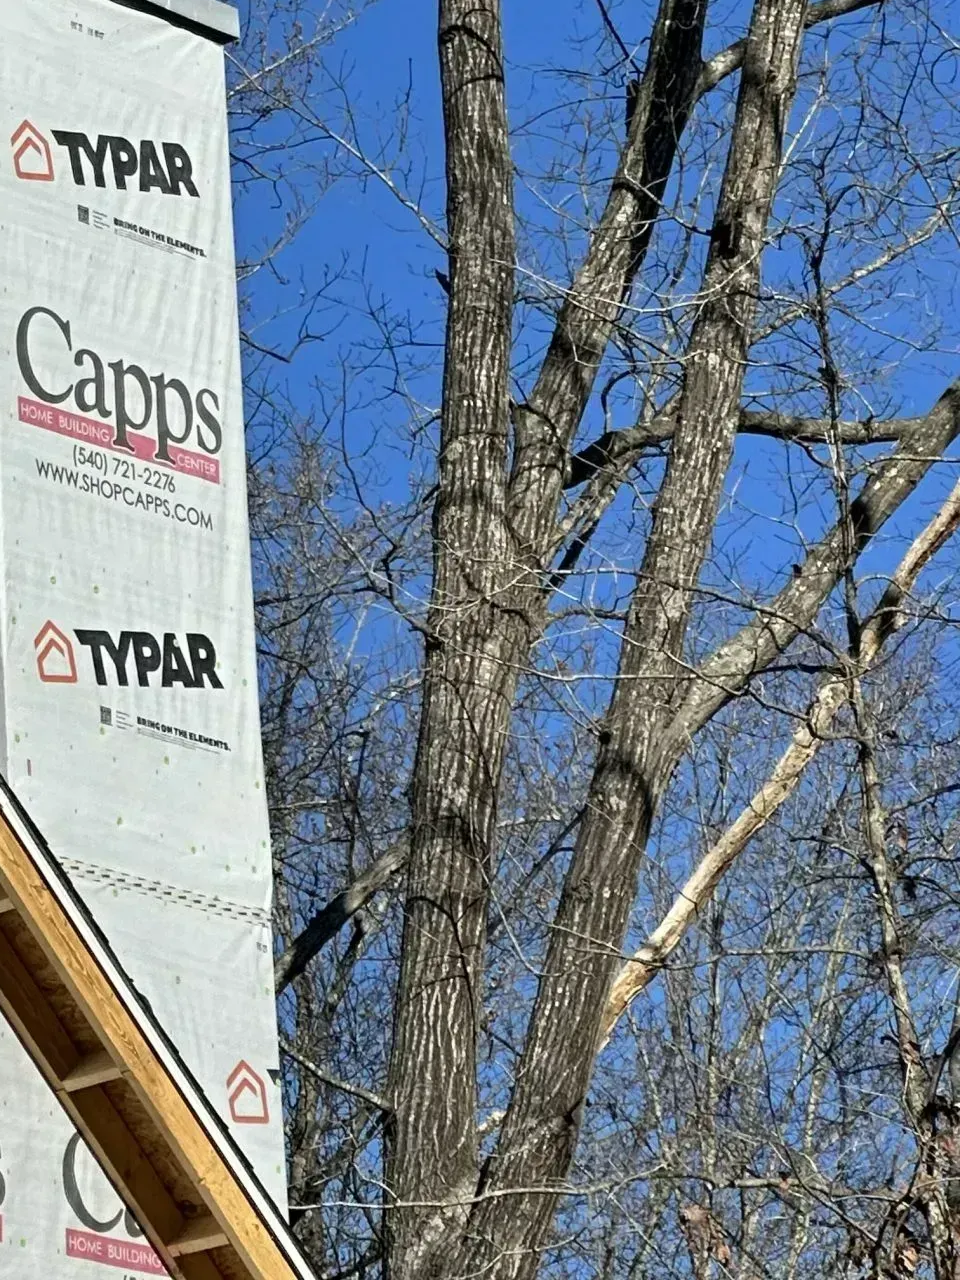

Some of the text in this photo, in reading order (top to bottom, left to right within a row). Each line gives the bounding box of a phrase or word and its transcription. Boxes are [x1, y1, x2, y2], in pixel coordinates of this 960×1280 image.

[50, 129, 200, 198] TYPAR
[113, 217, 138, 233] BRING
[138, 226, 150, 237] ON
[151, 230, 165, 243] THE
[16, 306, 222, 466] Capps
[20, 403, 217, 474] HOME BUILDING CENTER
[73, 444, 176, 493] (540) 721-2276
[35, 458, 214, 531] WWW.SHOPCAPPS.COM
[73, 629, 225, 689] TYPAR
[137, 716, 160, 731] BRING
[161, 723, 173, 734] ON
[174, 727, 187, 739] THE
[69, 1236, 162, 1269] HOME BUILDING
